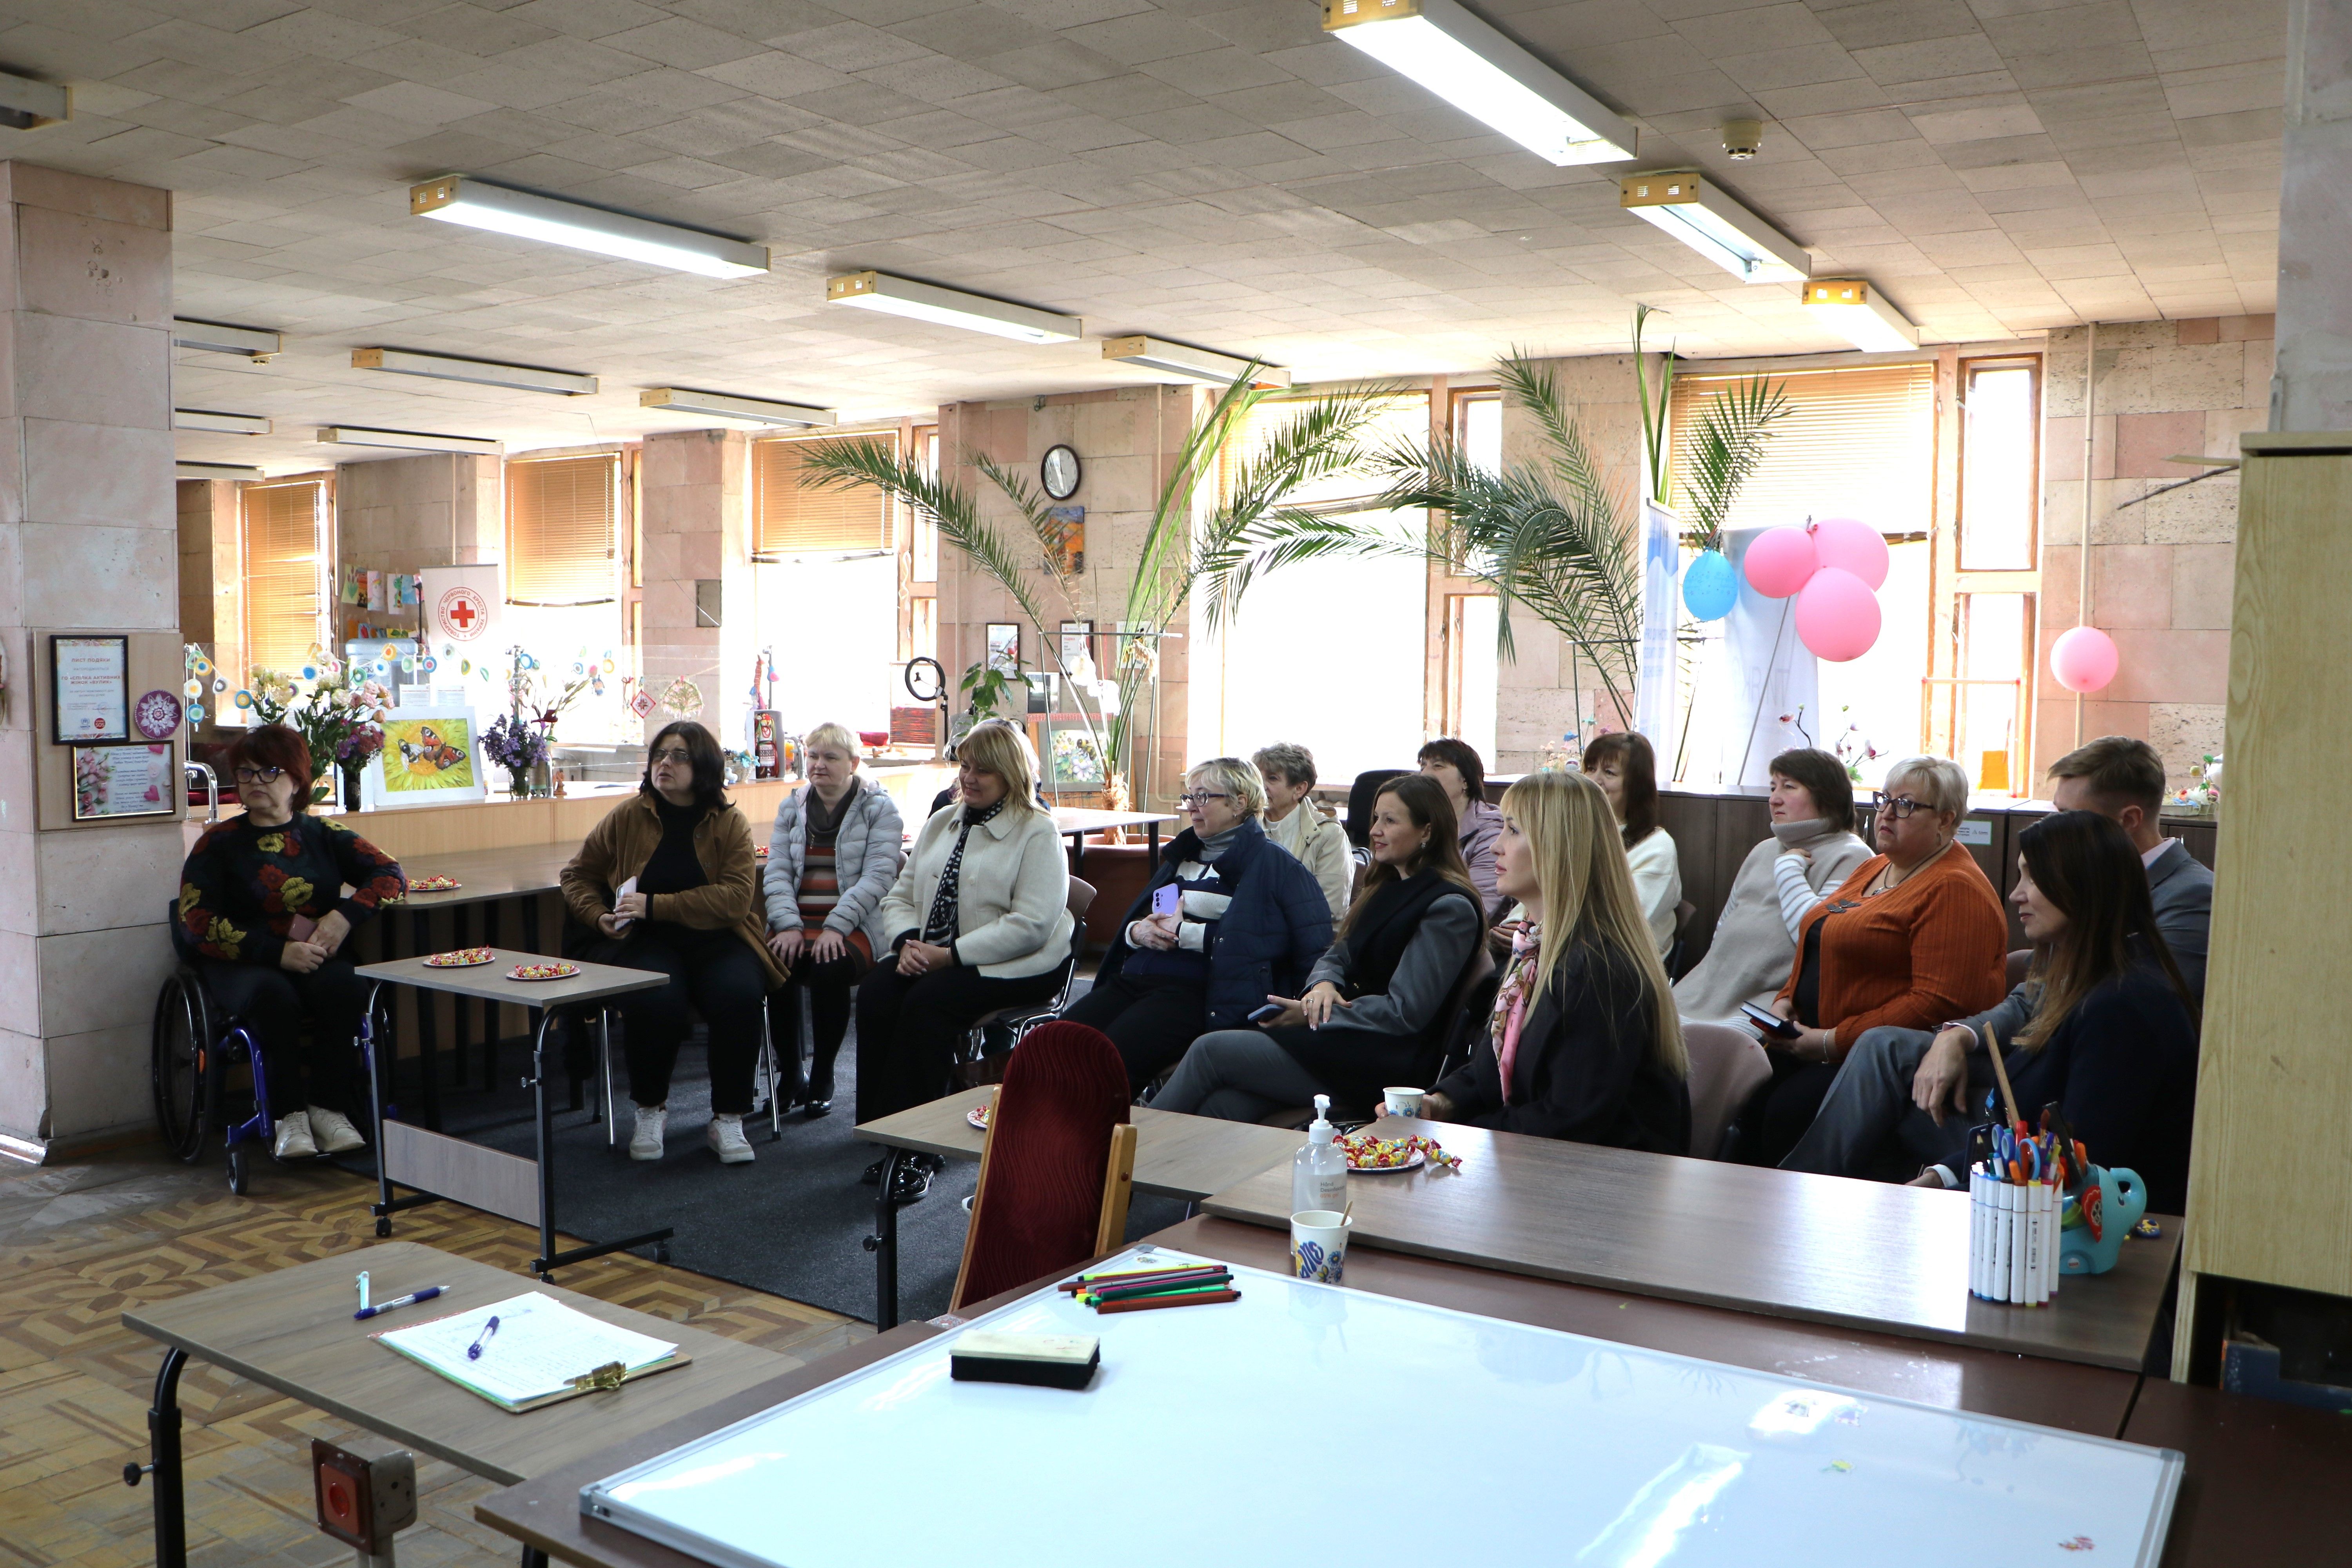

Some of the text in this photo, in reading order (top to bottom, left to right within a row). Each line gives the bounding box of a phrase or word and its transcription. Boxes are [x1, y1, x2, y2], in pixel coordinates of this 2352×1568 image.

[441, 590, 485, 637] ТОВАРИСТВО ЧЕРВОНОГО ХРЕСТА УКРАЇНИ
